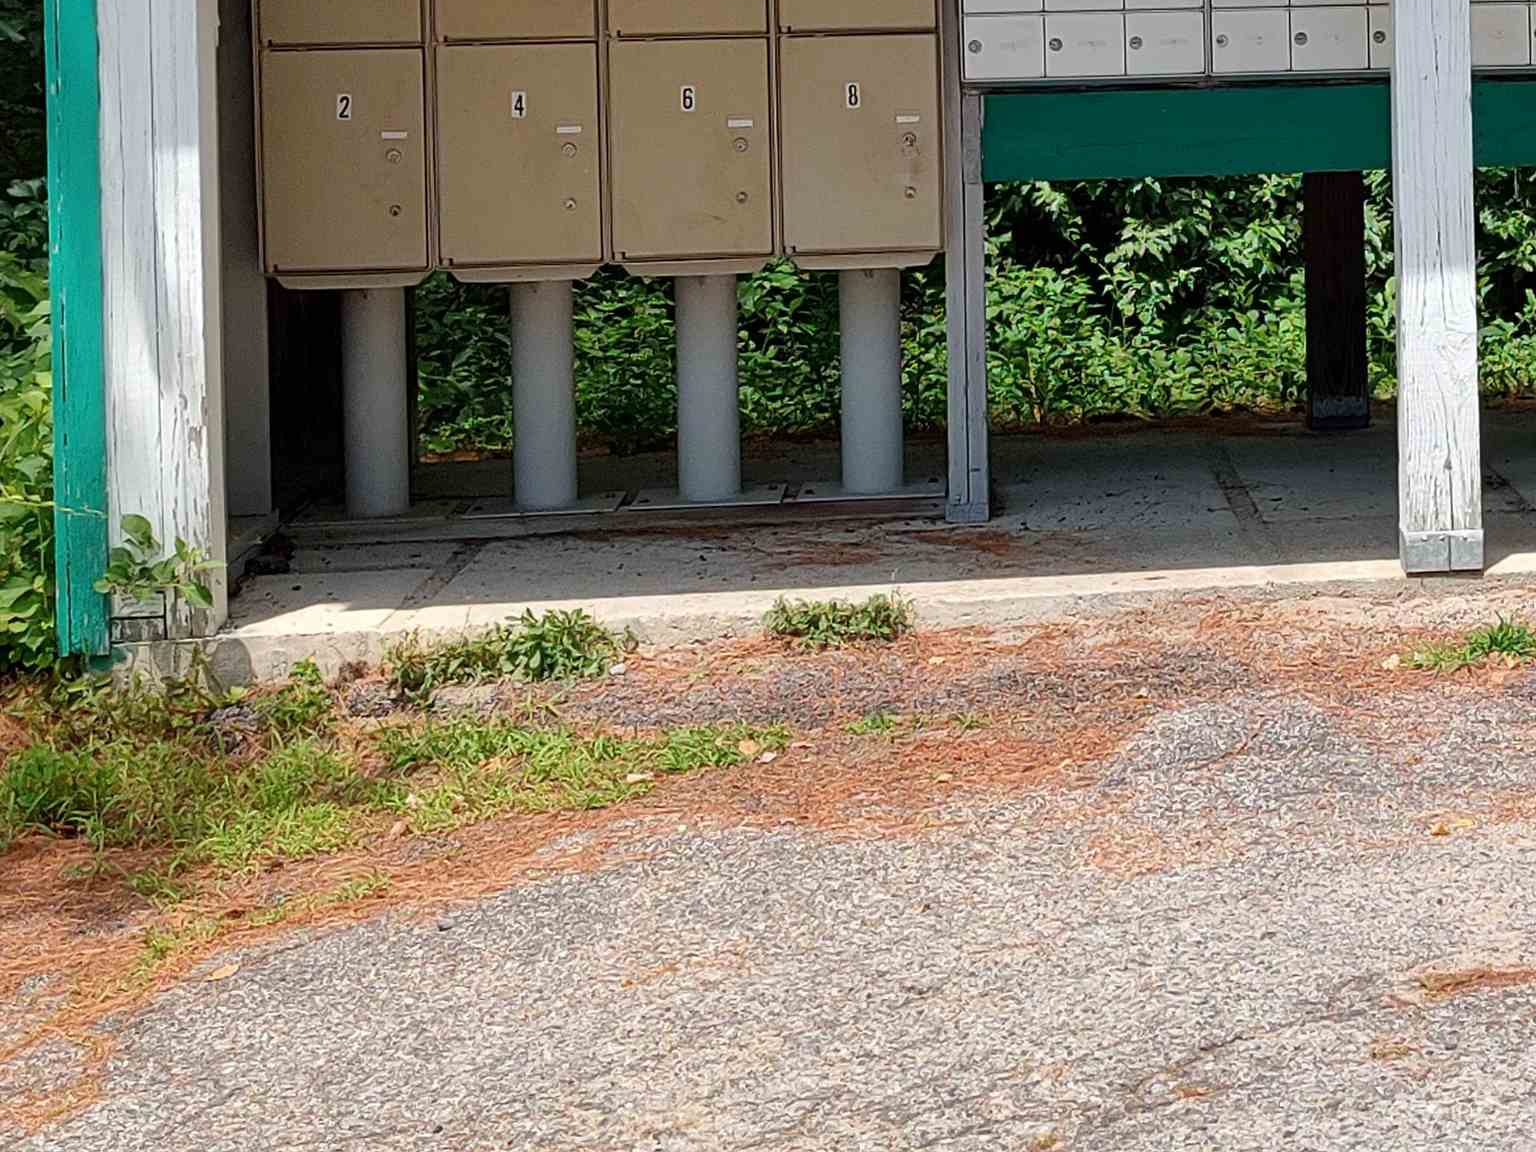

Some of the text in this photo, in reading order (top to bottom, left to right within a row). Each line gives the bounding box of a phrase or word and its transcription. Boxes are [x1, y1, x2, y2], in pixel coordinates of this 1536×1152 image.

[338, 95, 350, 119] 2
[513, 94, 524, 117] 4
[681, 87, 694, 110] 6
[847, 84, 858, 107] 8
